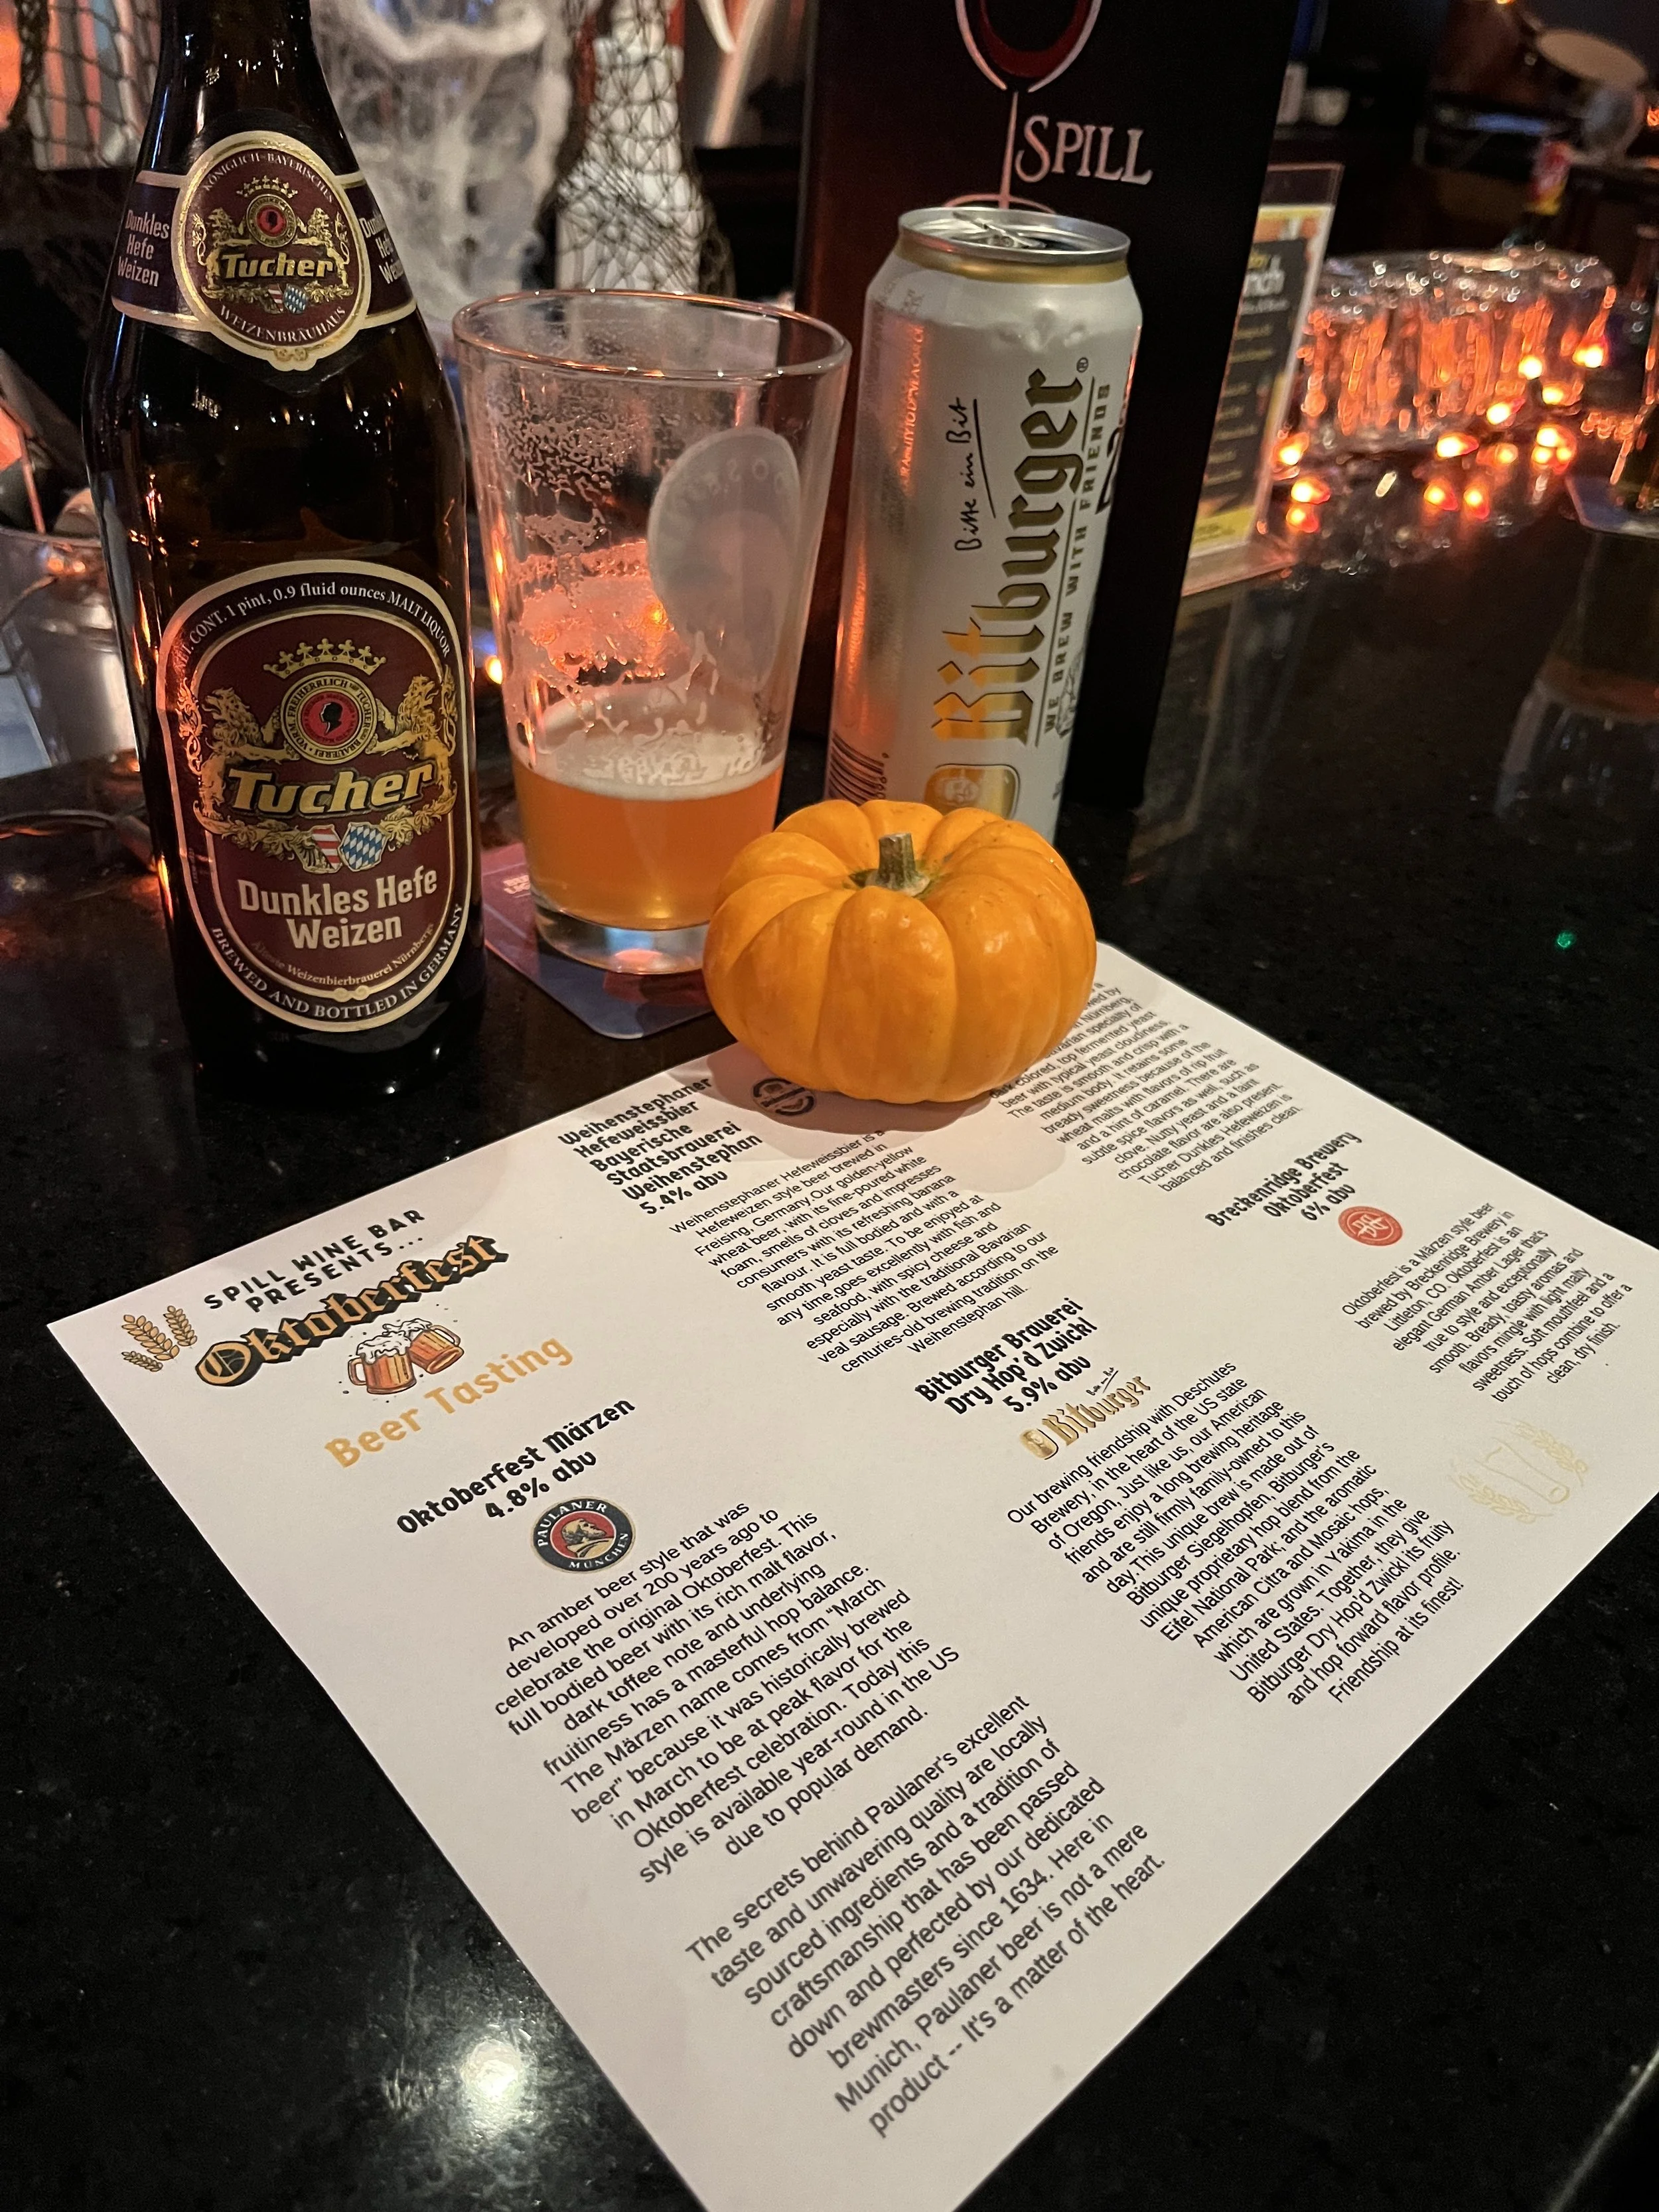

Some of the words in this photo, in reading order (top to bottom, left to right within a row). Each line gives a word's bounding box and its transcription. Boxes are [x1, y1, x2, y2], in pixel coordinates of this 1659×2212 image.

[1015, 115, 1153, 185] SPILL
[125, 209, 170, 239] Dunkles
[126, 234, 154, 259] Hefe
[221, 252, 334, 278] Tucher
[117, 256, 159, 287] Weizen
[946, 397, 972, 443] Bit
[959, 453, 974, 488] ein
[931, 368, 1084, 746] Bitburger
[1045, 697, 1058, 734] WE
[1052, 612, 1073, 684] BREW
[1066, 526, 1088, 597] WITH
[1079, 384, 1110, 510] FRIENDS
[190, 610, 227, 644] CONT.
[226, 605, 237, 617] 1
[238, 593, 272, 617] pint,
[273, 585, 296, 601] 0.9
[300, 581, 336, 597] fluid
[340, 585, 386, 601] ounces
[386, 591, 423, 619] MALT
[421, 612, 451, 658] LIQUOR
[229, 764, 433, 814] Tucher
[238, 879, 370, 916] Dunkles
[376, 865, 437, 909] Hefe
[286, 916, 402, 949] Weizen
[212, 928, 268, 992] BREWED
[269, 990, 310, 1013] AND
[315, 995, 398, 1019] BOTTLED
[399, 981, 418, 999] IN
[419, 903, 463, 983] GERMANY
[287, 963, 393, 986] Weizenbierbrauerei
[557, 1078, 712, 1145] Weihenstephaner
[572, 1100, 700, 1159] Hefeweissbier
[589, 1124, 693, 1173] Bayerische
[605, 1120, 743, 1186] Staatsbrauerei
[1118, 1147, 1173, 1180] chocolate
[1167, 1128, 1203, 1150] flavor
[1200, 1118, 1222, 1132] are
[1218, 1104, 1244, 1120] also
[1240, 1082, 1284, 1109] present.
[1136, 1159, 1182, 1185] Tucher
[1176, 1133, 1226, 1163] Dunkles
[1219, 1099, 1283, 1137] Hefeweizen
[1278, 1093, 1293, 1102] is
[620, 1135, 763, 1201] Weihenstephan
[638, 1186, 693, 1215] 5.4%
[692, 1170, 729, 1191] abv
[693, 1226, 755, 1257] Freising,
[835, 1146, 914, 1189] golden-yellow
[1204, 1167, 1303, 1227] Breckenridge
[1293, 1131, 1363, 1171] Brewery
[1262, 1161, 1350, 1218] Oktoberfest
[1300, 1201, 1331, 1221] 6%
[1325, 1183, 1356, 1205] abv
[203, 1270, 287, 1310] SPILL
[290, 1234, 364, 1272] WINE
[366, 1209, 425, 1240] BAR
[736, 1248, 809, 1289] consumers
[806, 1235, 837, 1252] with
[831, 1227, 853, 1239] its
[850, 1197, 914, 1231] refreshing
[907, 1175, 957, 1200] banana
[195, 1234, 509, 1387] Oktoberfest
[244, 1236, 423, 1313] PRESENTS...
[806, 1309, 873, 1350] especially
[869, 1295, 901, 1313] with
[897, 1284, 922, 1299] the
[918, 1249, 981, 1287] traditional
[976, 1222, 1032, 1255] Bavarian
[1392, 1319, 1435, 1351] elegant
[1426, 1290, 1472, 1323] German
[1464, 1266, 1501, 1294] Amber
[1492, 1246, 1526, 1270] Lager
[906, 1297, 1007, 1353] Weihenstephan
[1001, 1284, 1029, 1300] hill.
[914, 1343, 1008, 1402] Bitburger
[1001, 1297, 1084, 1350] Brauerei
[1546, 1359, 1582, 1384] clean,
[1571, 1342, 1597, 1360] dry
[1585, 1322, 1622, 1347] finish.
[324, 1408, 422, 1467] Beer
[423, 1338, 574, 1415] Tasting
[943, 1385, 994, 1415] Dry
[1031, 1316, 1098, 1361] Zwickl
[1001, 1376, 1058, 1413] 5.9%
[1054, 1355, 1092, 1382] abv
[1007, 1500, 1038, 1524] Our
[1032, 1464, 1094, 1505] brewing
[1085, 1422, 1151, 1468] friendship
[1146, 1404, 1178, 1425] with
[1171, 1362, 1237, 1408] Deschutes
[1041, 1376, 1151, 1447] Bitburger
[396, 1446, 547, 1534] Oktoberfest
[541, 1400, 636, 1454] Märzen
[484, 1477, 551, 1518] 4.8%
[551, 1451, 597, 1483] abv
[537, 1501, 607, 1547] PAULANER
[1125, 1554, 1192, 1606] Bitburger
[1186, 1493, 1277, 1558] Siegelhopfen,
[1267, 1442, 1335, 1494] Bitburger's
[1192, 1593, 1260, 1649] American
[1253, 1567, 1292, 1595] Citra
[1285, 1544, 1315, 1571] and
[1306, 1511, 1356, 1550] Mosaic
[1347, 1487, 1390, 1515] hops,
[1228, 1637, 1281, 1682] United
[1273, 1605, 1325, 1644] States.
[1315, 1554, 1384, 1604] Together,
[1373, 1529, 1407, 1556] they
[1401, 1510, 1430, 1536] give
[494, 1657, 583, 1716] celebrate
[582, 1636, 616, 1660] the
[616, 1593, 684, 1639] original
[681, 1537, 782, 1599] Oktoberfest.
[777, 1512, 818, 1538] This
[563, 1698, 611, 1732] dark
[606, 1664, 663, 1702] toffee
[662, 1638, 705, 1668] note
[704, 1613, 741, 1643] and
[738, 1563, 827, 1621] underlying
[542, 1712, 634, 1777] fruitiness
[630, 1688, 671, 1717] has
[670, 1678, 689, 1692] a
[685, 1625, 768, 1683] masterful
[762, 1607, 801, 1633] hop
[796, 1565, 869, 1611] balance.
[633, 1765, 748, 1848] Oktoberfest
[745, 1701, 848, 1771] celebration.
[841, 1659, 900, 1700] Today
[895, 1638, 930, 1664] this
[684, 1925, 733, 1962] The
[732, 1868, 806, 1929] secrets
[800, 1816, 870, 1873] behind
[863, 1752, 958, 1825] Paulaner's
[956, 1695, 1031, 1755] excellent
[770, 1910, 904, 2027] craftsmanship
[901, 1877, 944, 1915] that
[935, 1850, 977, 1885] has
[969, 1813, 1022, 1855] been
[1017, 1759, 1080, 1821] passed
[826, 1955, 956, 2070] brewmasters
[952, 1911, 1004, 1959] since
[999, 1868, 1054, 1915] 1634.
[1047, 1830, 1096, 1871] Here
[1087, 1814, 1114, 1834] in
